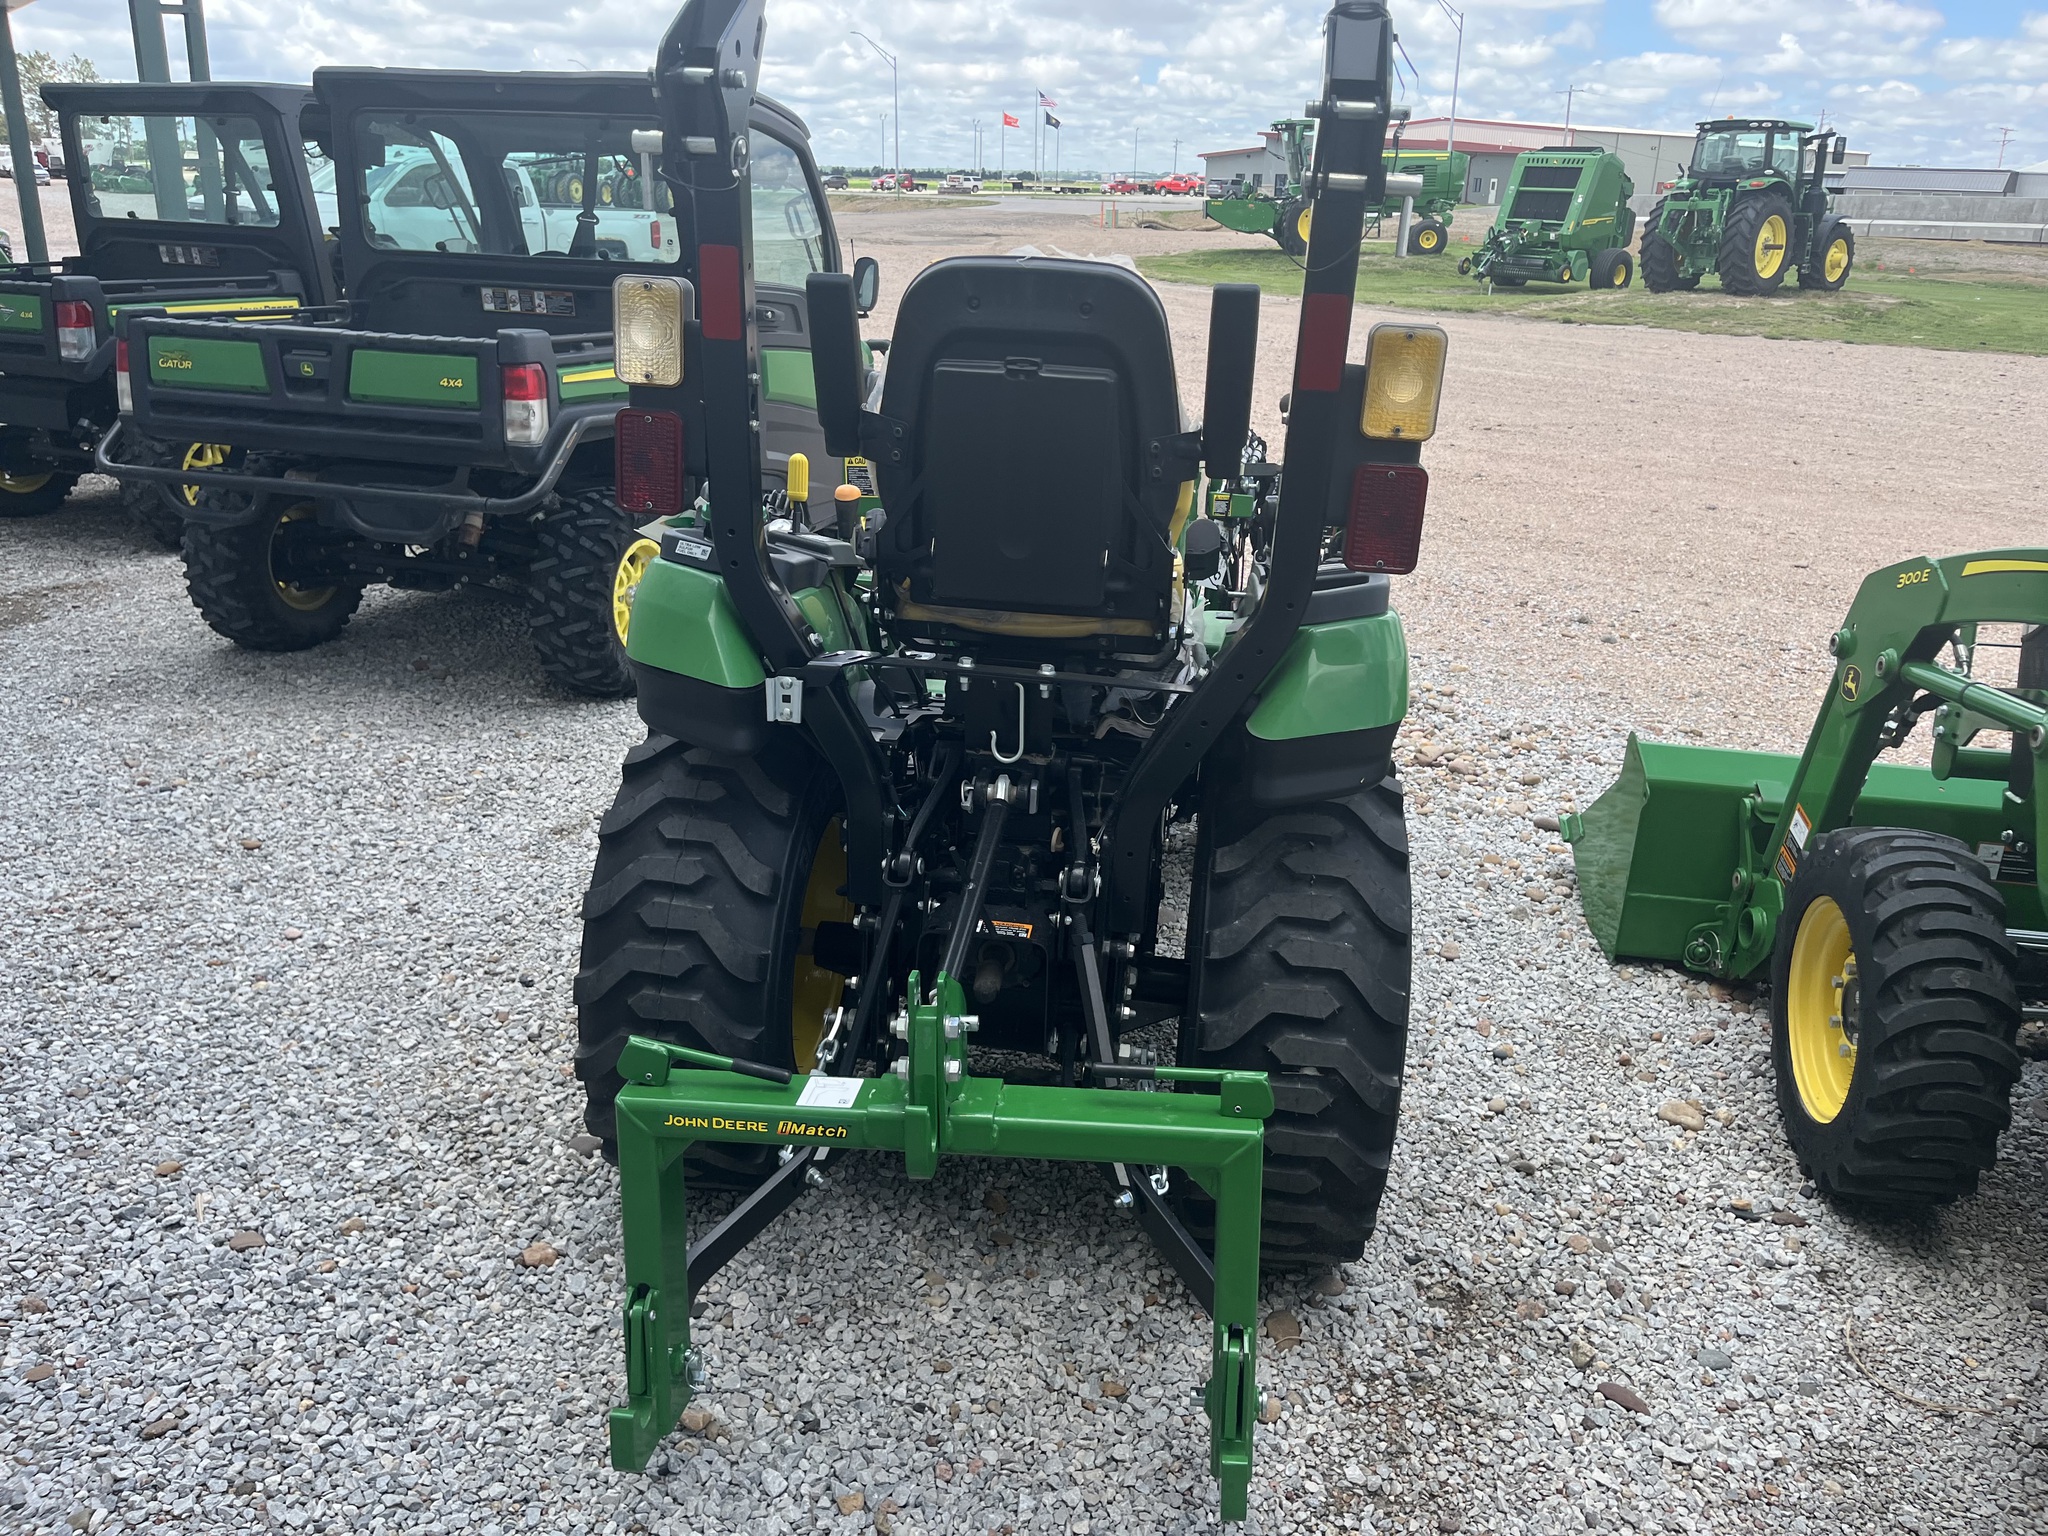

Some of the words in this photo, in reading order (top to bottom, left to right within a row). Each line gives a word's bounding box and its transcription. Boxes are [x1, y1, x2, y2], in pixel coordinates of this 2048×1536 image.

[158, 358, 192, 369] GATOR
[440, 377, 463, 388] 4x4
[664, 1114, 708, 1129] JOHN
[712, 1117, 769, 1133] DEERE
[777, 1120, 848, 1138] iMatch
